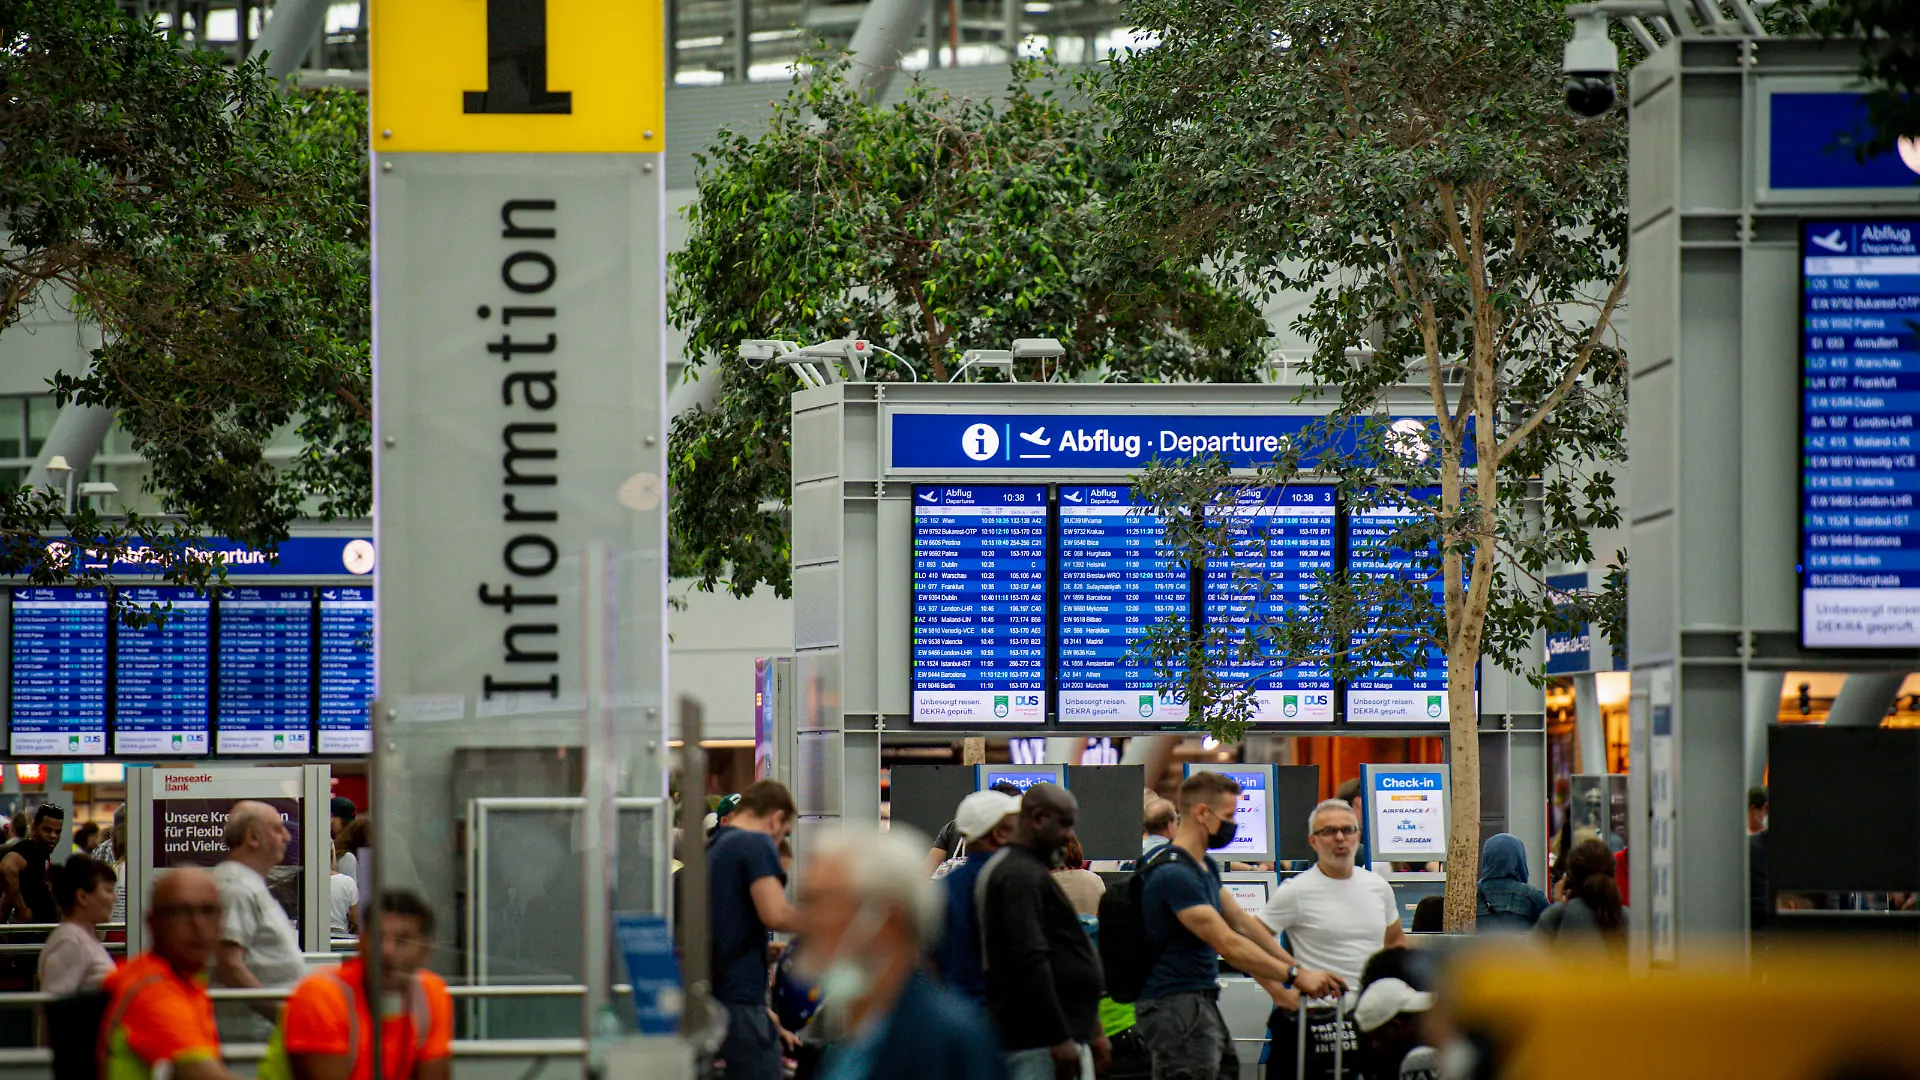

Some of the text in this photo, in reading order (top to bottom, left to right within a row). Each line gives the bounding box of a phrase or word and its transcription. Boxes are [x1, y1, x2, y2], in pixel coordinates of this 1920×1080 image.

[1862, 226, 1910, 243] Abflug
[1059, 429, 1140, 458] Abflug
[478, 198, 559, 700] Information
[946, 489, 971, 498] Abflug
[1037, 493, 1040, 501] 1
[1091, 489, 1116, 498] Abflug
[1325, 493, 1330, 501] 3
[1016, 696, 1038, 705] DUS
[1305, 695, 1327, 705] DUS
[165, 774, 212, 782] Hanseatic
[1383, 778, 1434, 788] Check-in
[165, 783, 189, 791] Bank
[165, 812, 208, 823] Unsere
[165, 826, 182, 837] für
[165, 841, 188, 852] und
